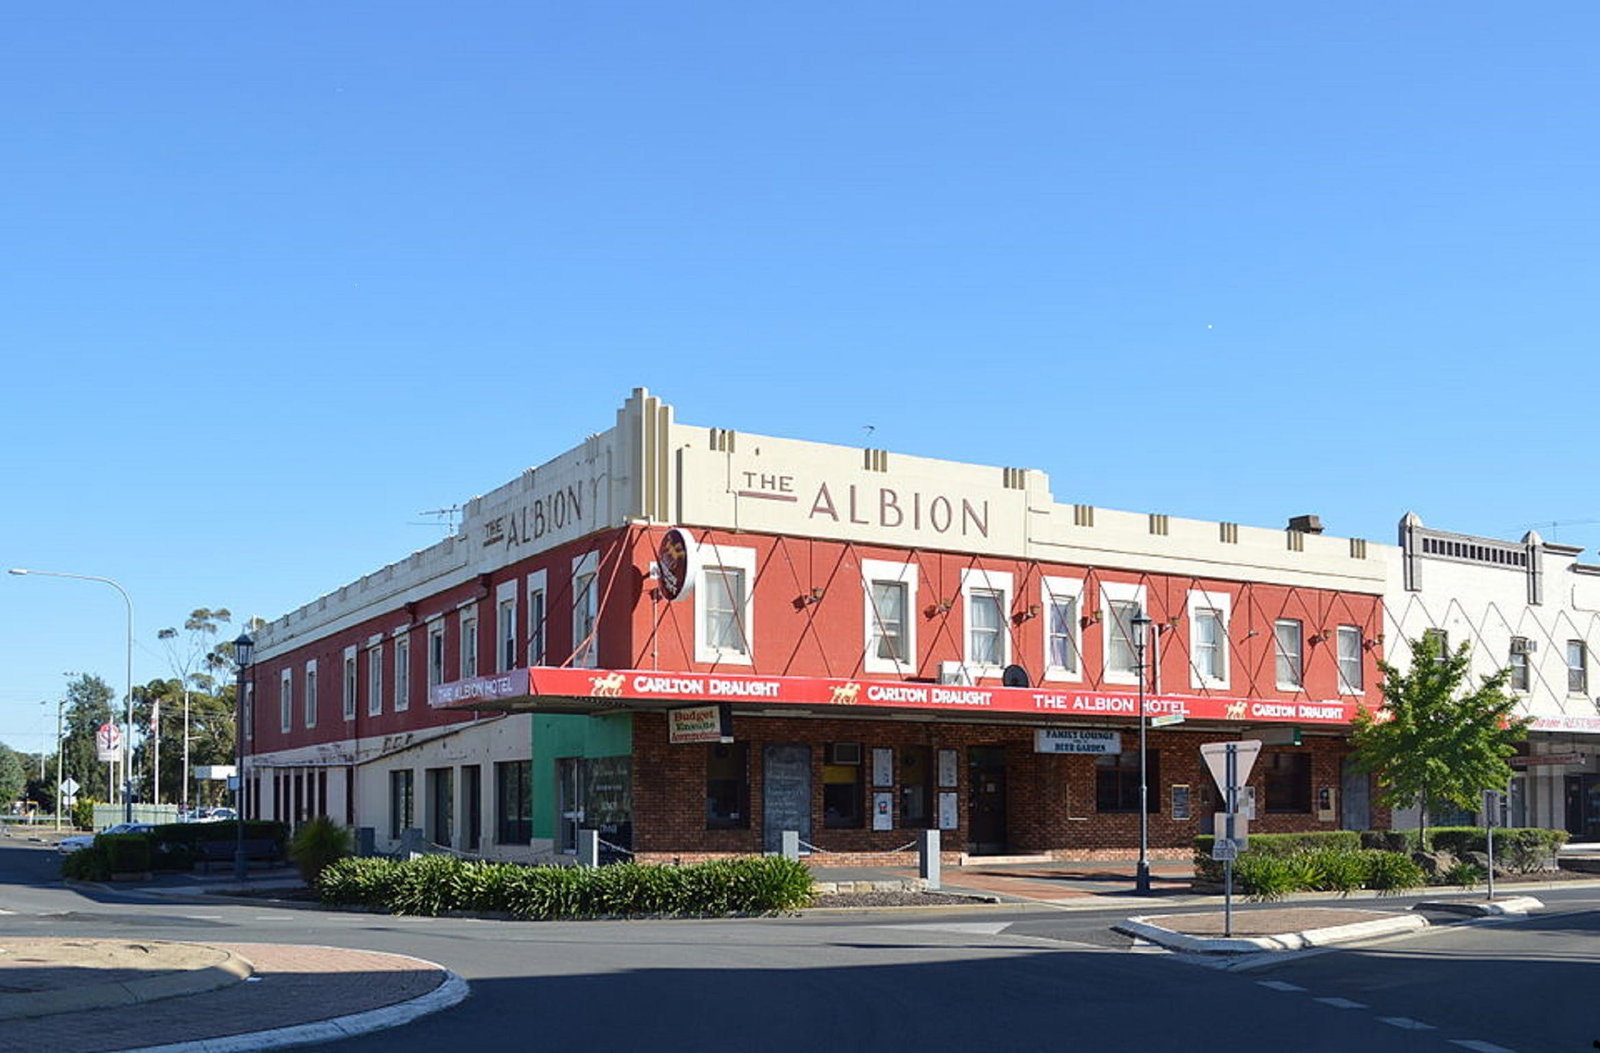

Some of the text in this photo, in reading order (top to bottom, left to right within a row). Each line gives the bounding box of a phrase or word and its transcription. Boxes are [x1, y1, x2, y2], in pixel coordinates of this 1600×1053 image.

[743, 471, 989, 539] THE ALBION
[484, 480, 583, 551] THE ALBION
[438, 677, 513, 702] THE ALBION HOTEL
[633, 676, 780, 697] CARLTON DRAUGHT
[867, 686, 992, 705] CARLTON DRAUGHT
[1032, 694, 1067, 709] THE
[1072, 696, 1135, 713] ALBION
[1252, 703, 1344, 719] CARLTON DRAUGHT
[674, 710, 714, 722] Budget
[1046, 730, 1114, 740] FAMILY LOUNGE
